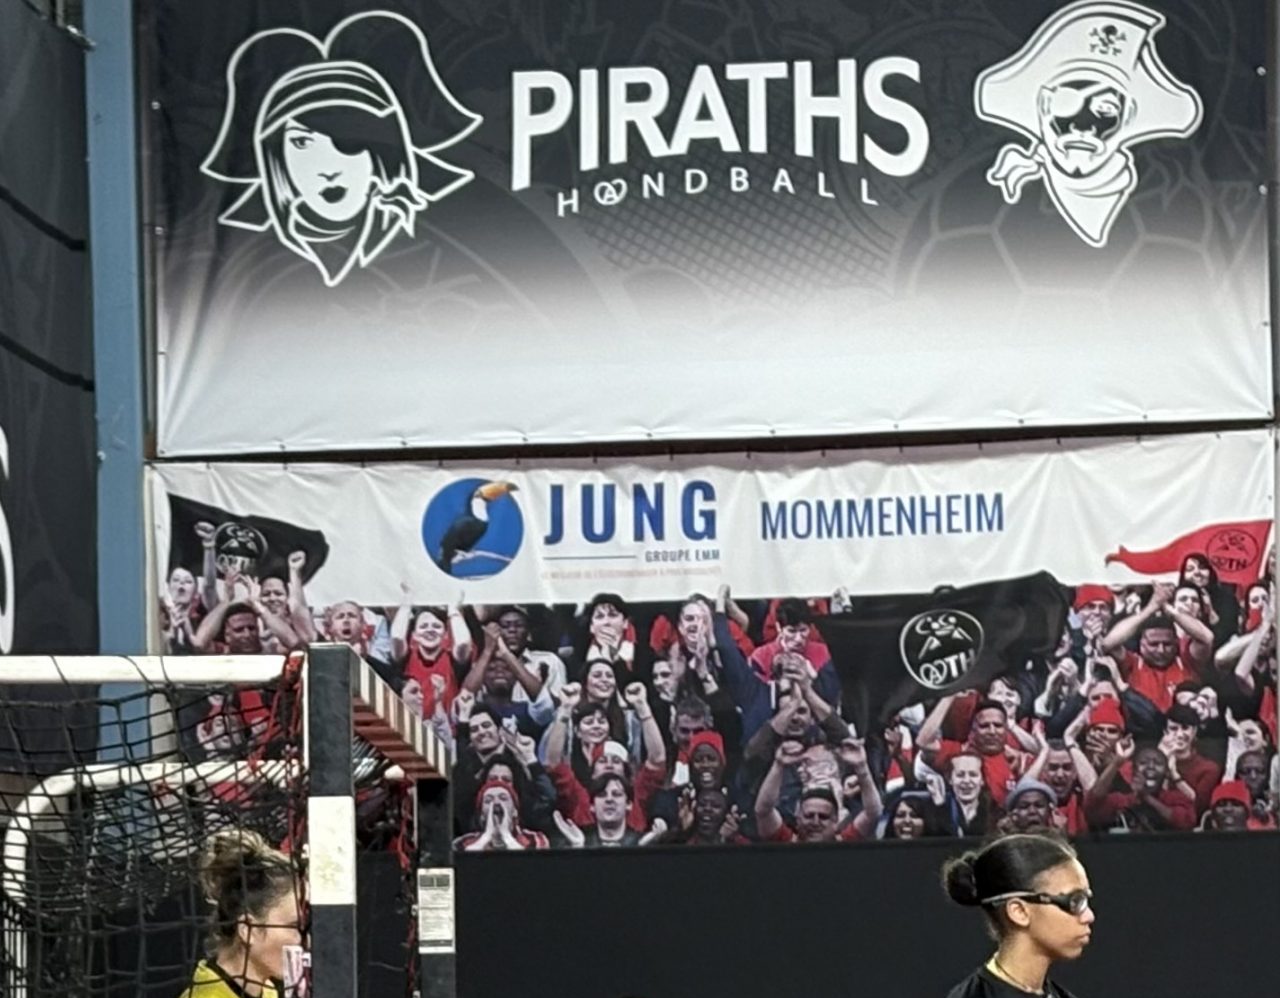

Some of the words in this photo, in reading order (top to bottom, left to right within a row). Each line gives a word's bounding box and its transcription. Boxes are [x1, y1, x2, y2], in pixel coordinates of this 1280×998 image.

[512, 56, 930, 191] PIRATHS
[543, 480, 717, 545] JUNG
[760, 493, 1004, 541] MOMMENHEIM
[645, 550, 691, 563] GROUPE
